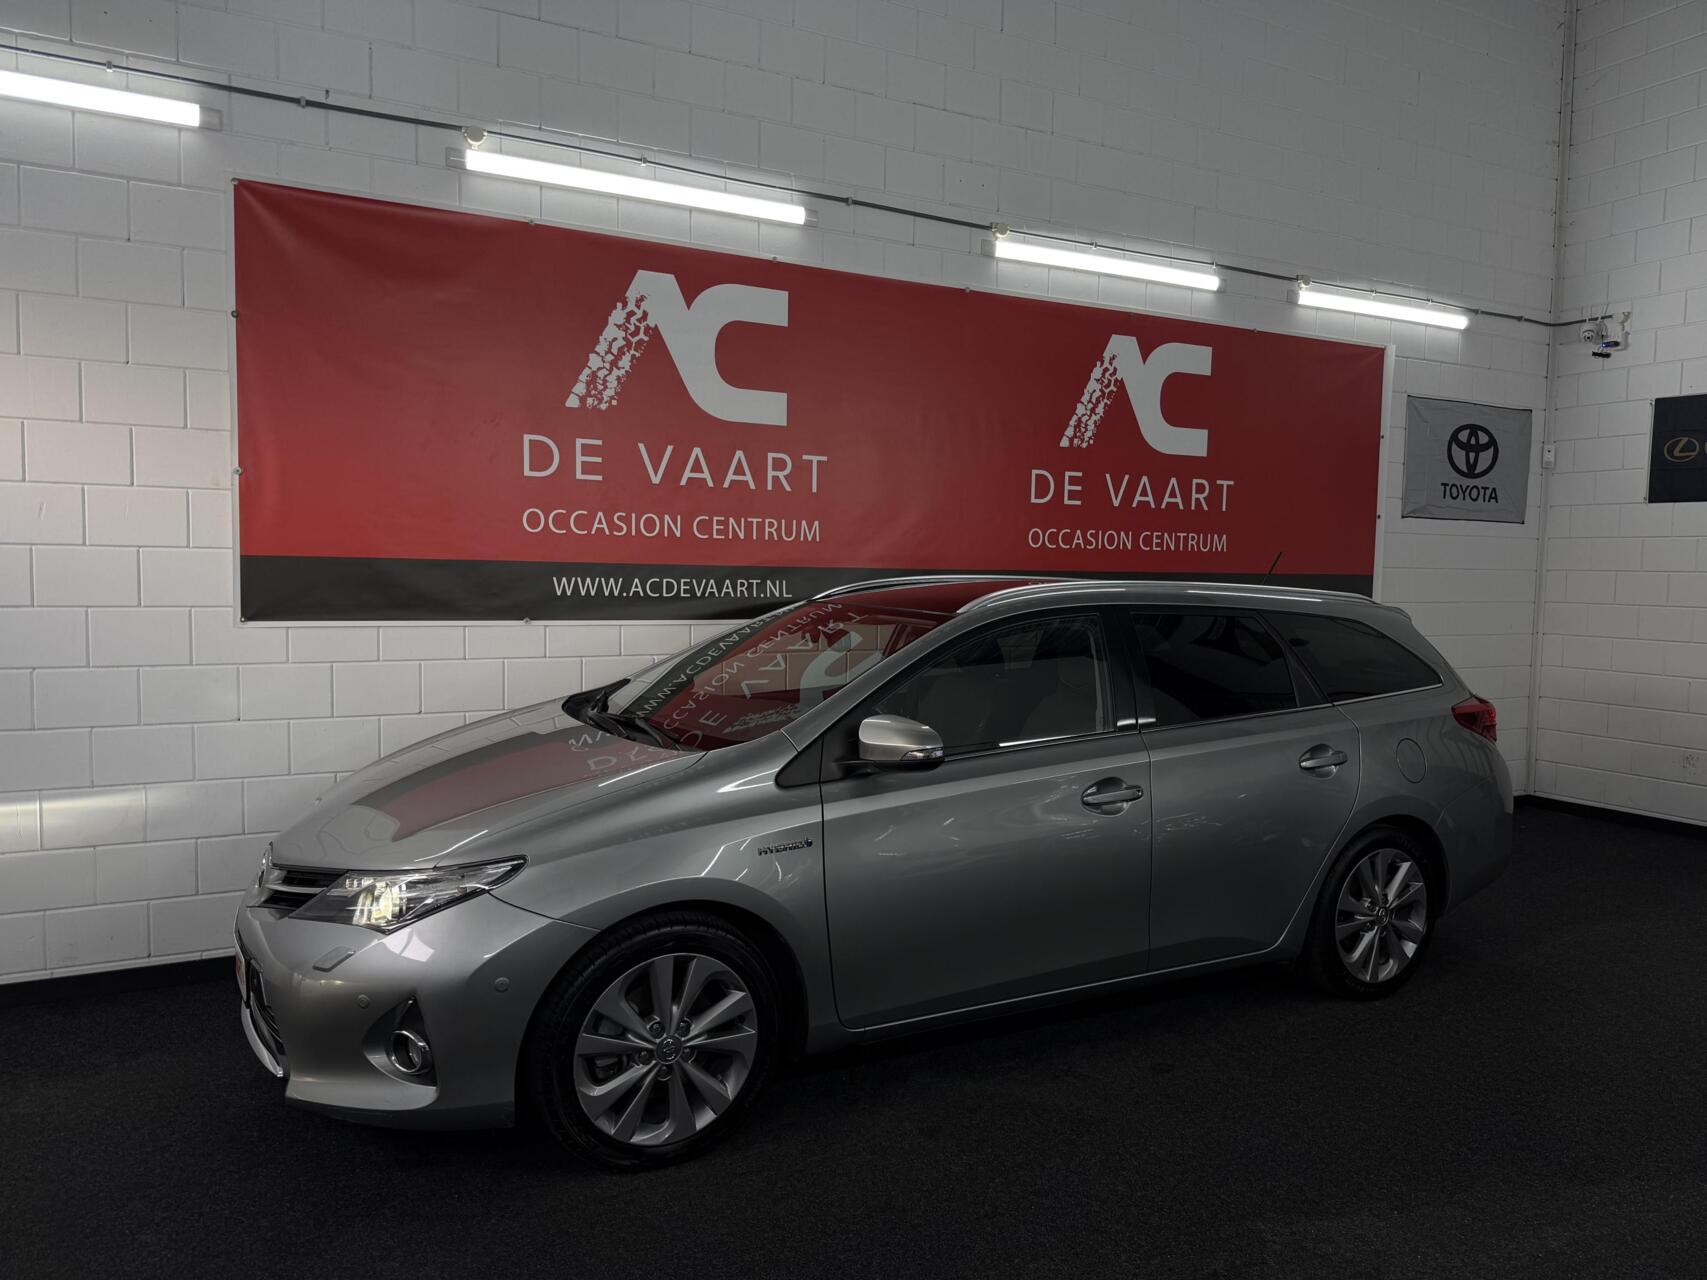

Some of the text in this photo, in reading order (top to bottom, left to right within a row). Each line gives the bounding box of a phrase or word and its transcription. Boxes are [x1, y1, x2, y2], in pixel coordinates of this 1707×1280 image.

[565, 269, 789, 426] AC
[1059, 334, 1213, 457] AC
[522, 433, 828, 493] DE VAART
[1030, 469, 1235, 512] DE VAART
[1440, 482, 1499, 504] TOYOTA
[521, 507, 821, 542] OCCASION CENTRUM
[1028, 527, 1227, 552] OCCASION CENTRUM
[552, 576, 793, 598] WWW.ACDEVAART.NL
